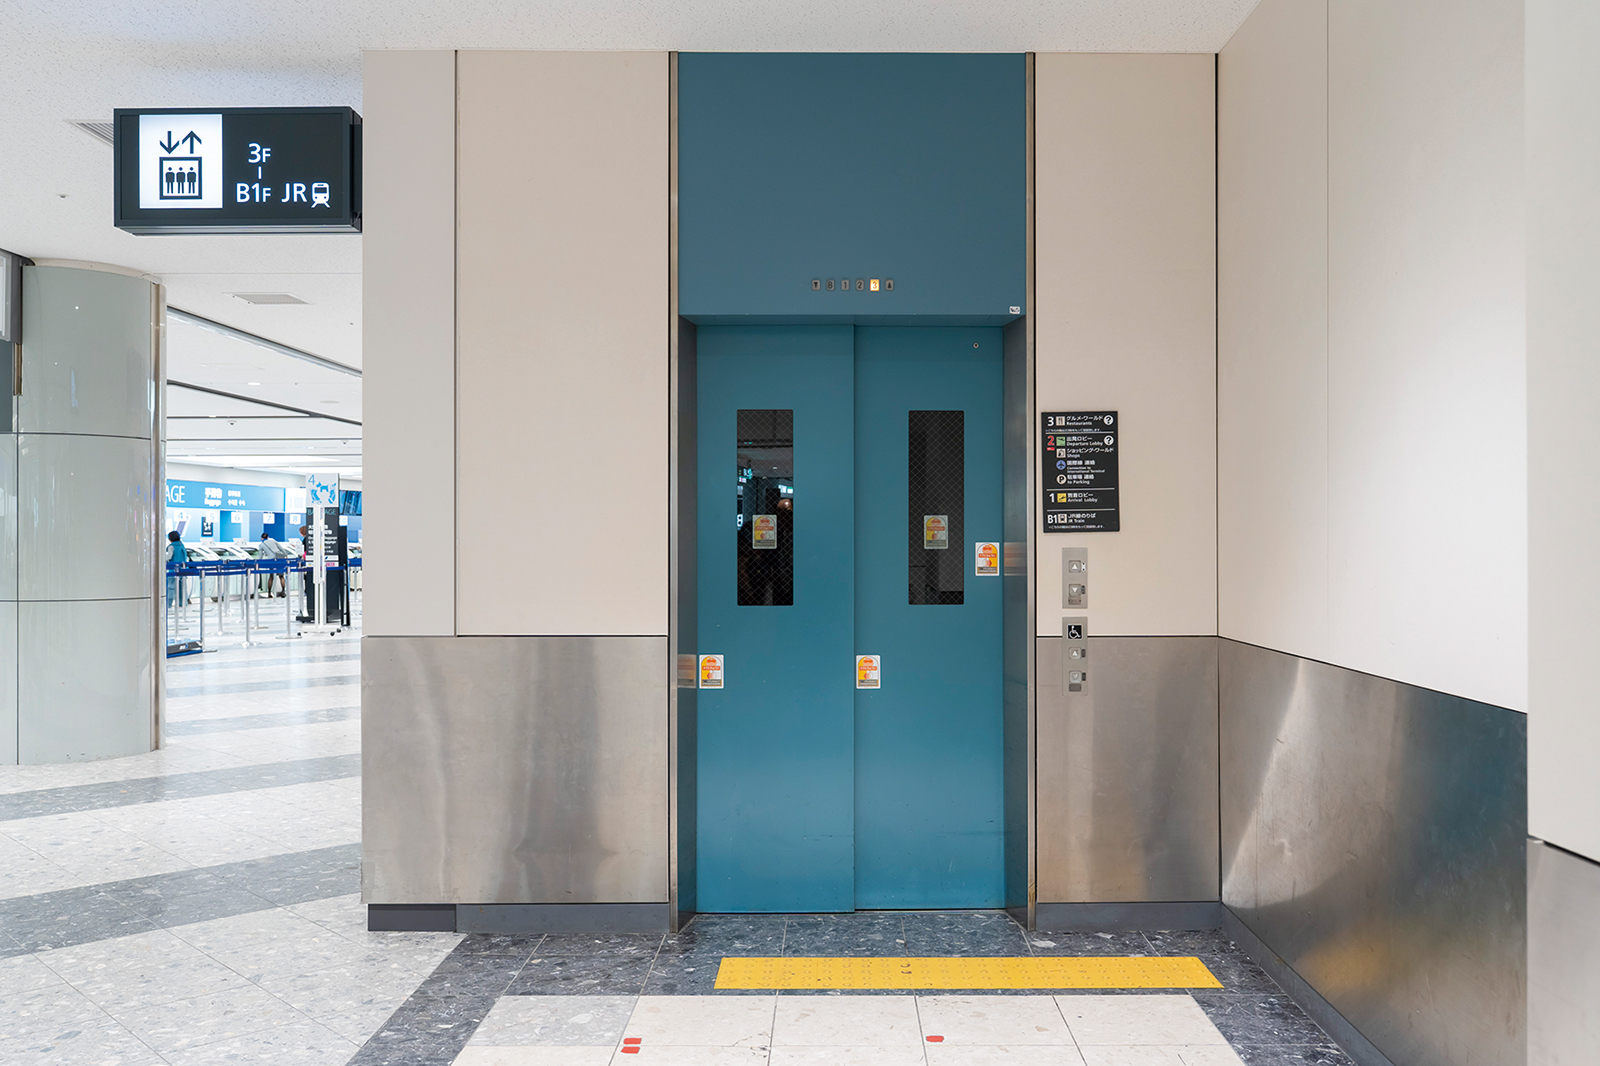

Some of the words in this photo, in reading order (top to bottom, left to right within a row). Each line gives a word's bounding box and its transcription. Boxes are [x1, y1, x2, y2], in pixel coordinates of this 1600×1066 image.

[248, 142, 271, 163] 3F
[236, 182, 271, 203] B1F
[281, 182, 307, 203] JR
[1047, 416, 1055, 427] 3
[1047, 435, 1055, 446] 2
[308, 474, 316, 485] 4
[1049, 493, 1054, 503] 1
[1047, 514, 1058, 524] B1
